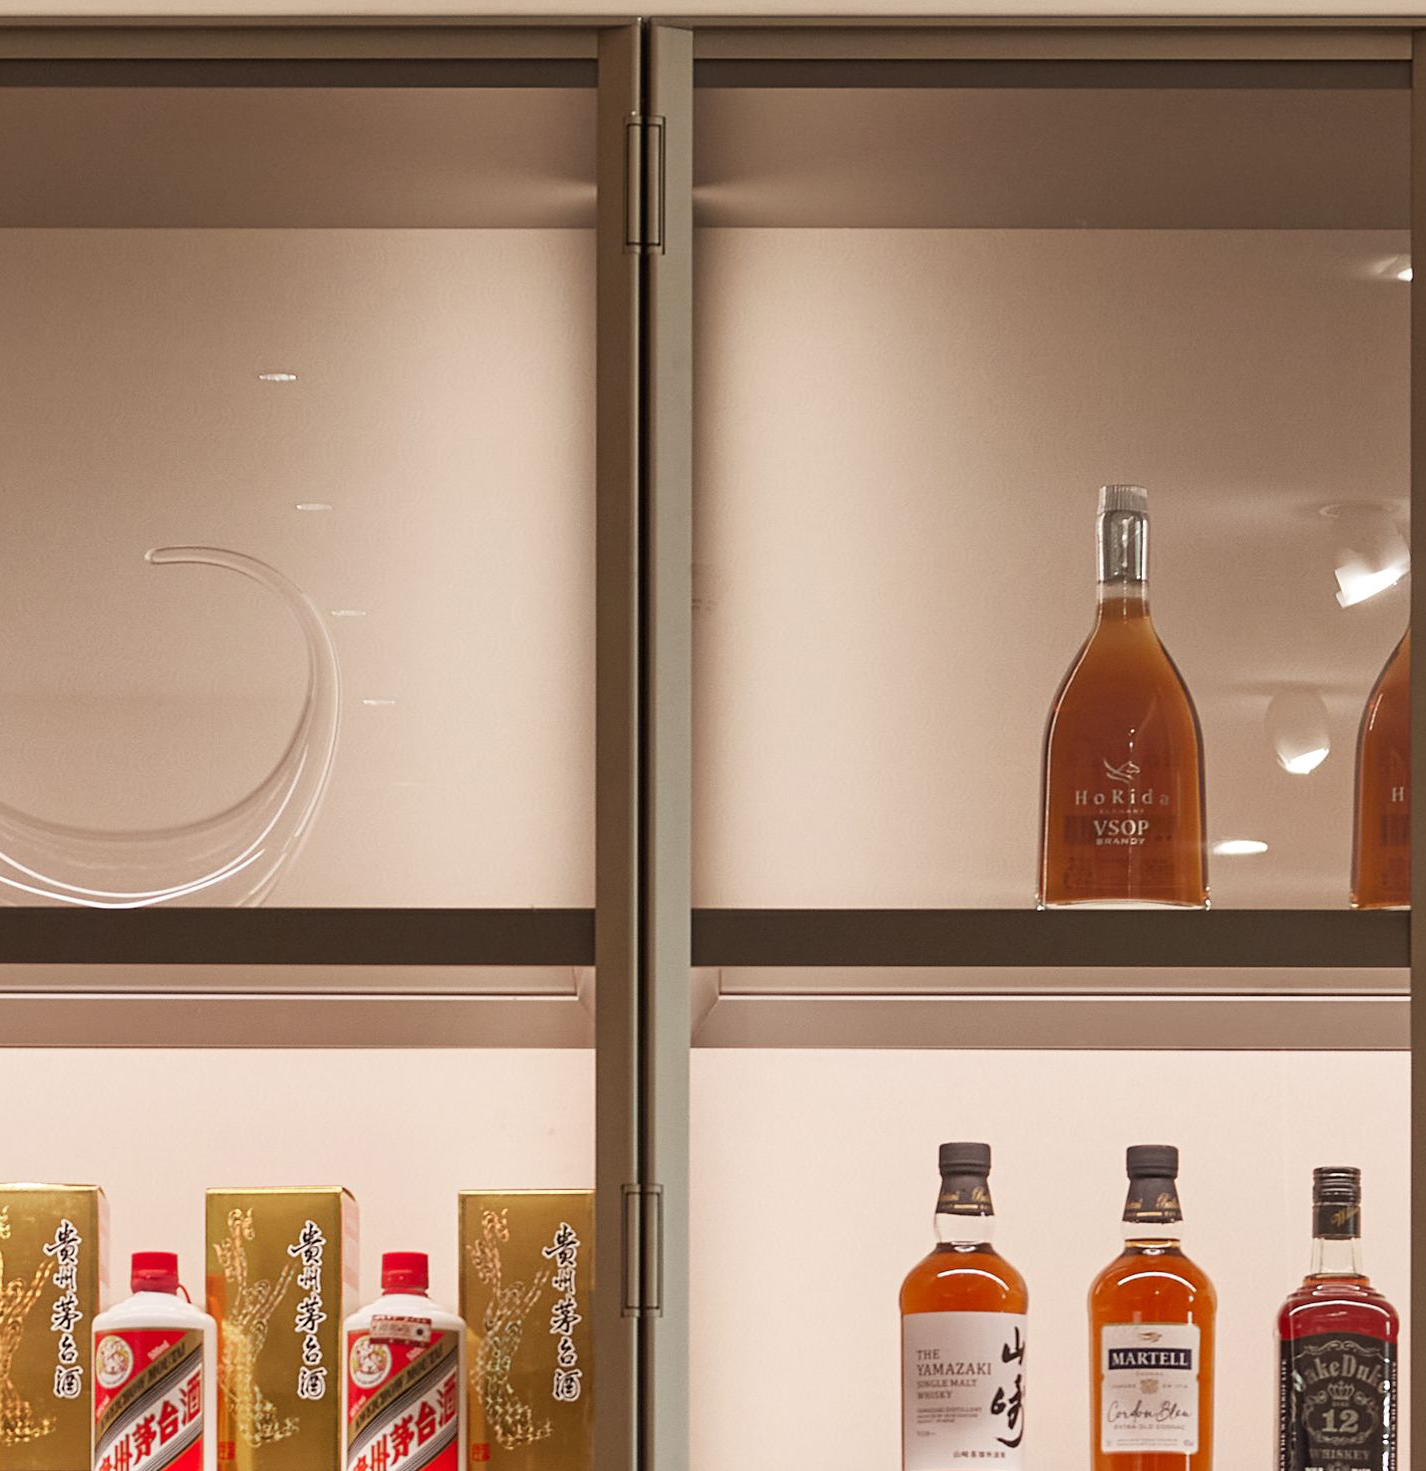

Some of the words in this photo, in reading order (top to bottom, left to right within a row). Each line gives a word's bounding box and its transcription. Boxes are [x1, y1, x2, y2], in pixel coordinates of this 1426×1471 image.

[1093, 819, 1150, 836] VSOP
[1095, 837, 1146, 846] BRANDY
[916, 1349, 941, 1361] THE
[1111, 1351, 1189, 1366] MARTELL
[916, 1362, 992, 1377] YAMAZAKI
[950, 1378, 977, 1388] MALT
[917, 1390, 953, 1400] WHISKY
[1322, 1408, 1360, 1433] 12
[1309, 1448, 1371, 1461] WHISKEY
